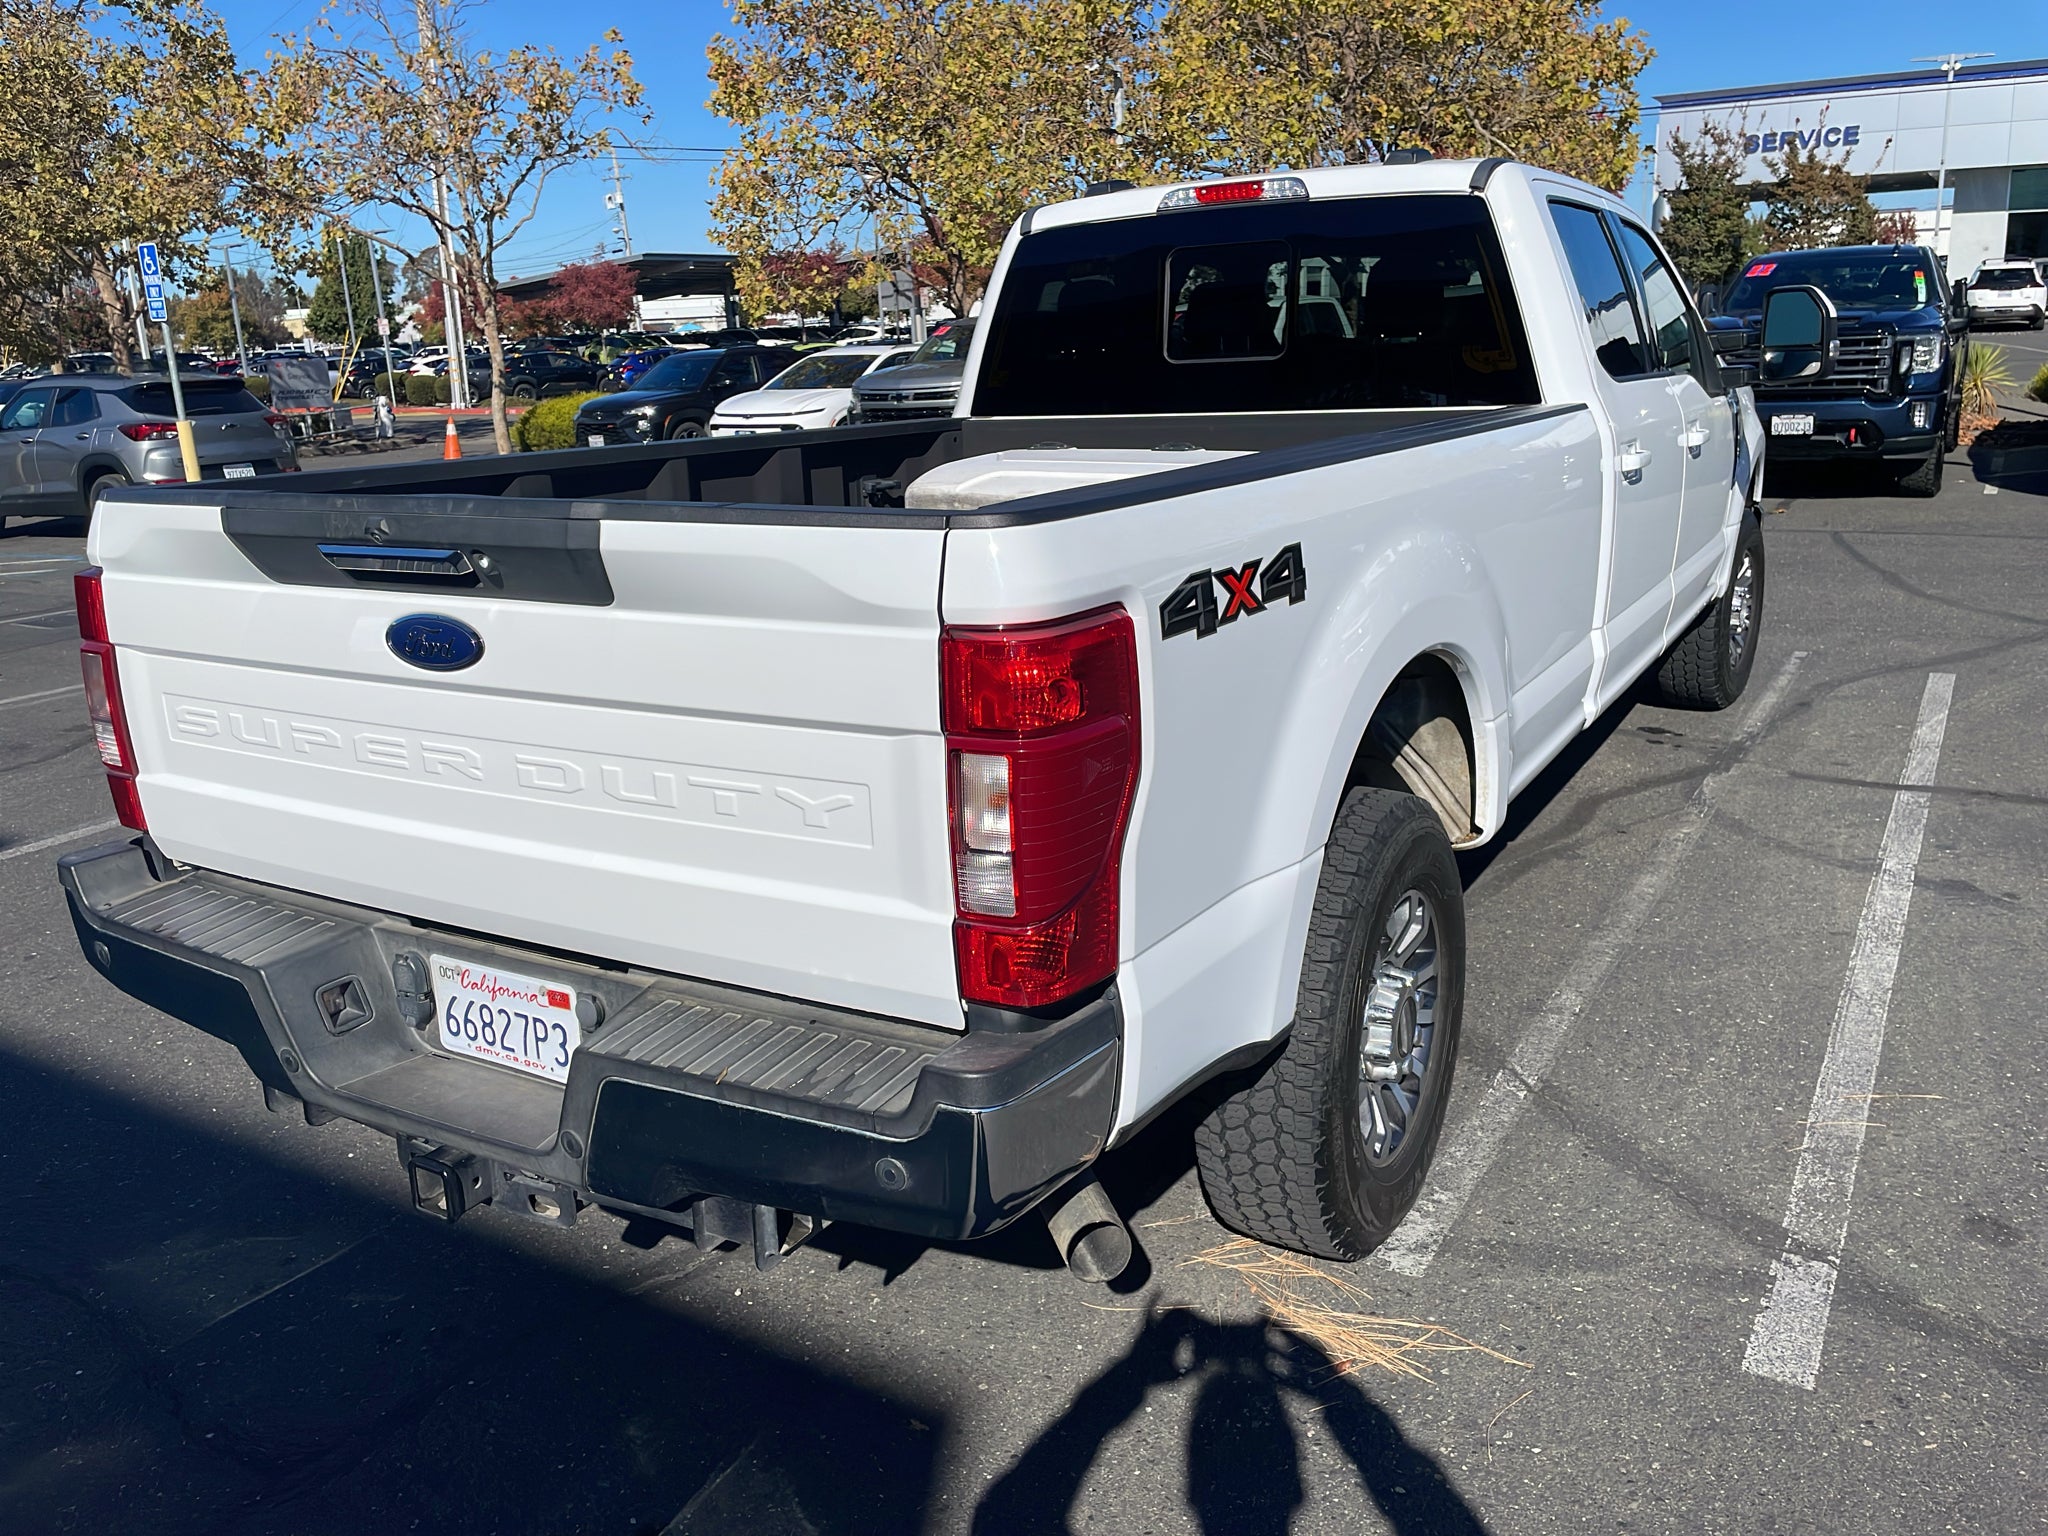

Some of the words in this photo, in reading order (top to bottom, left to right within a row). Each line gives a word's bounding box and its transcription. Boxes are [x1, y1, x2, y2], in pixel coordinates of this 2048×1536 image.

[1743, 125, 1861, 154] SERVICE
[404, 624, 456, 658] Ford
[174, 704, 484, 780] SUPER
[515, 753, 855, 829] DUTY
[439, 965, 455, 980] OCT
[460, 968, 549, 1008] California
[446, 995, 569, 1067] 66827P3
[475, 1045, 547, 1071] dmv.ca.gov
